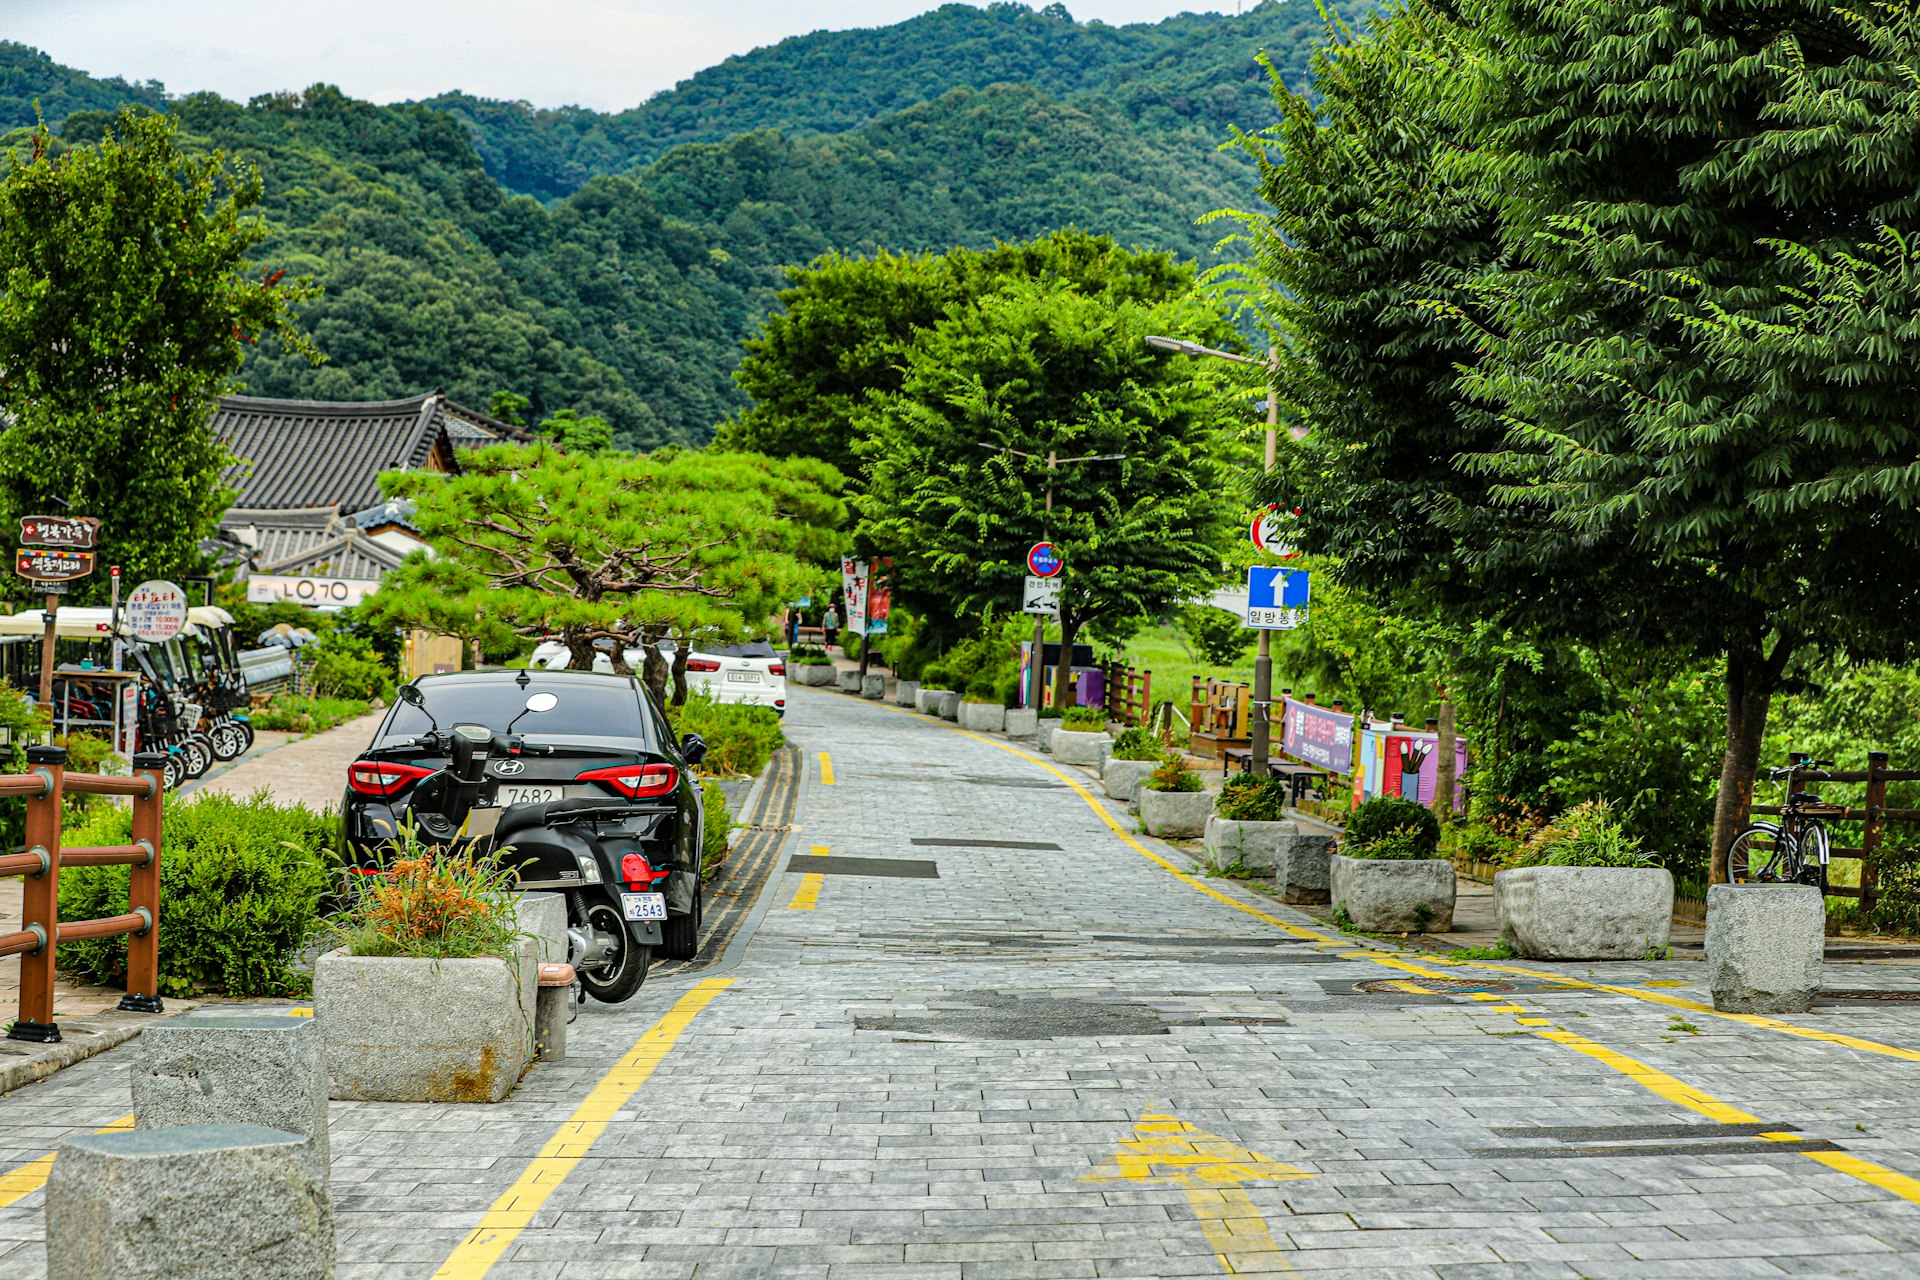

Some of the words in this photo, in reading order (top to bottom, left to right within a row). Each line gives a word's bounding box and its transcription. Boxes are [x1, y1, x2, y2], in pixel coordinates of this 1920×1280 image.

[37, 522, 83, 540] 행복가득
[31, 557, 80, 572] 색동저고리
[509, 789, 552, 804] 7682
[635, 904, 663, 917] 2543
